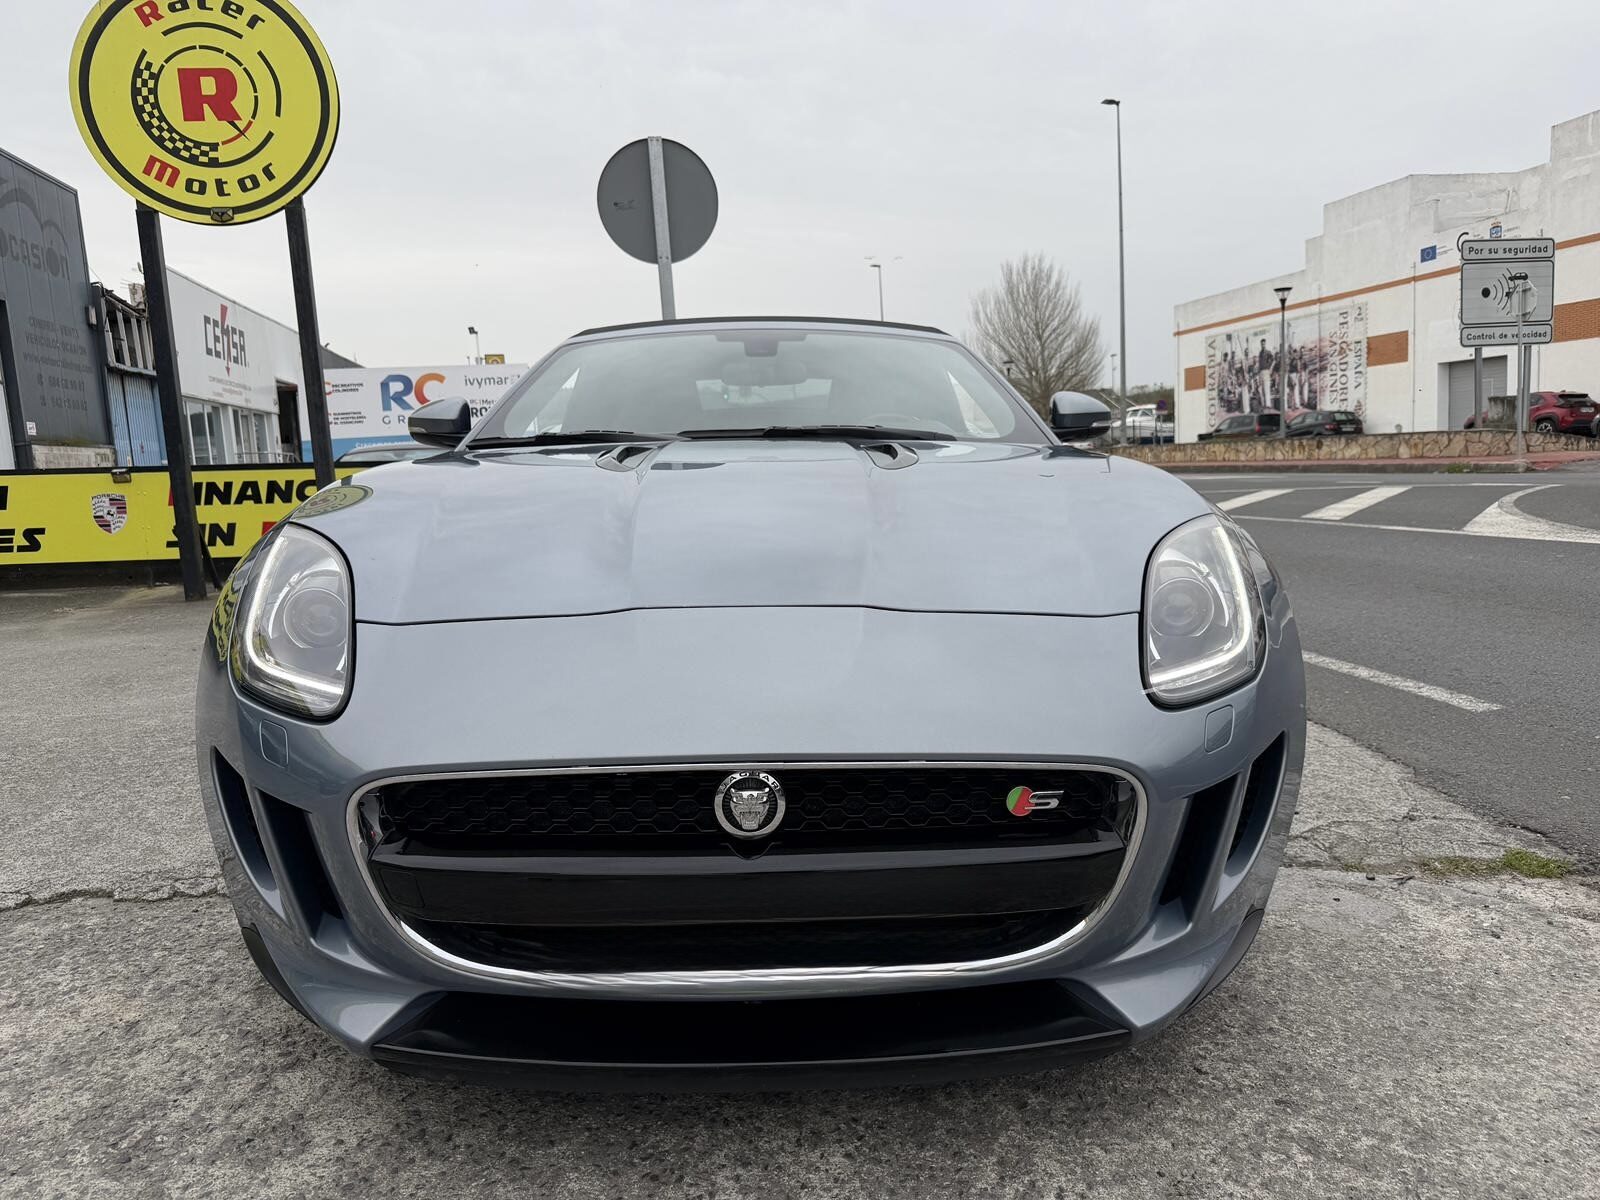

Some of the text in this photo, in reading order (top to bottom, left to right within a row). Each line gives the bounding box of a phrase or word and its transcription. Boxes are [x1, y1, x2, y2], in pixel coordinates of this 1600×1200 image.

[177, 67, 243, 122] R
[1468, 246, 1484, 255] Por
[1502, 245, 1549, 257] seguridad
[1466, 331, 1548, 341] Control de veocidad
[1338, 311, 1349, 412] PESCADORE
[380, 373, 447, 412] RC
